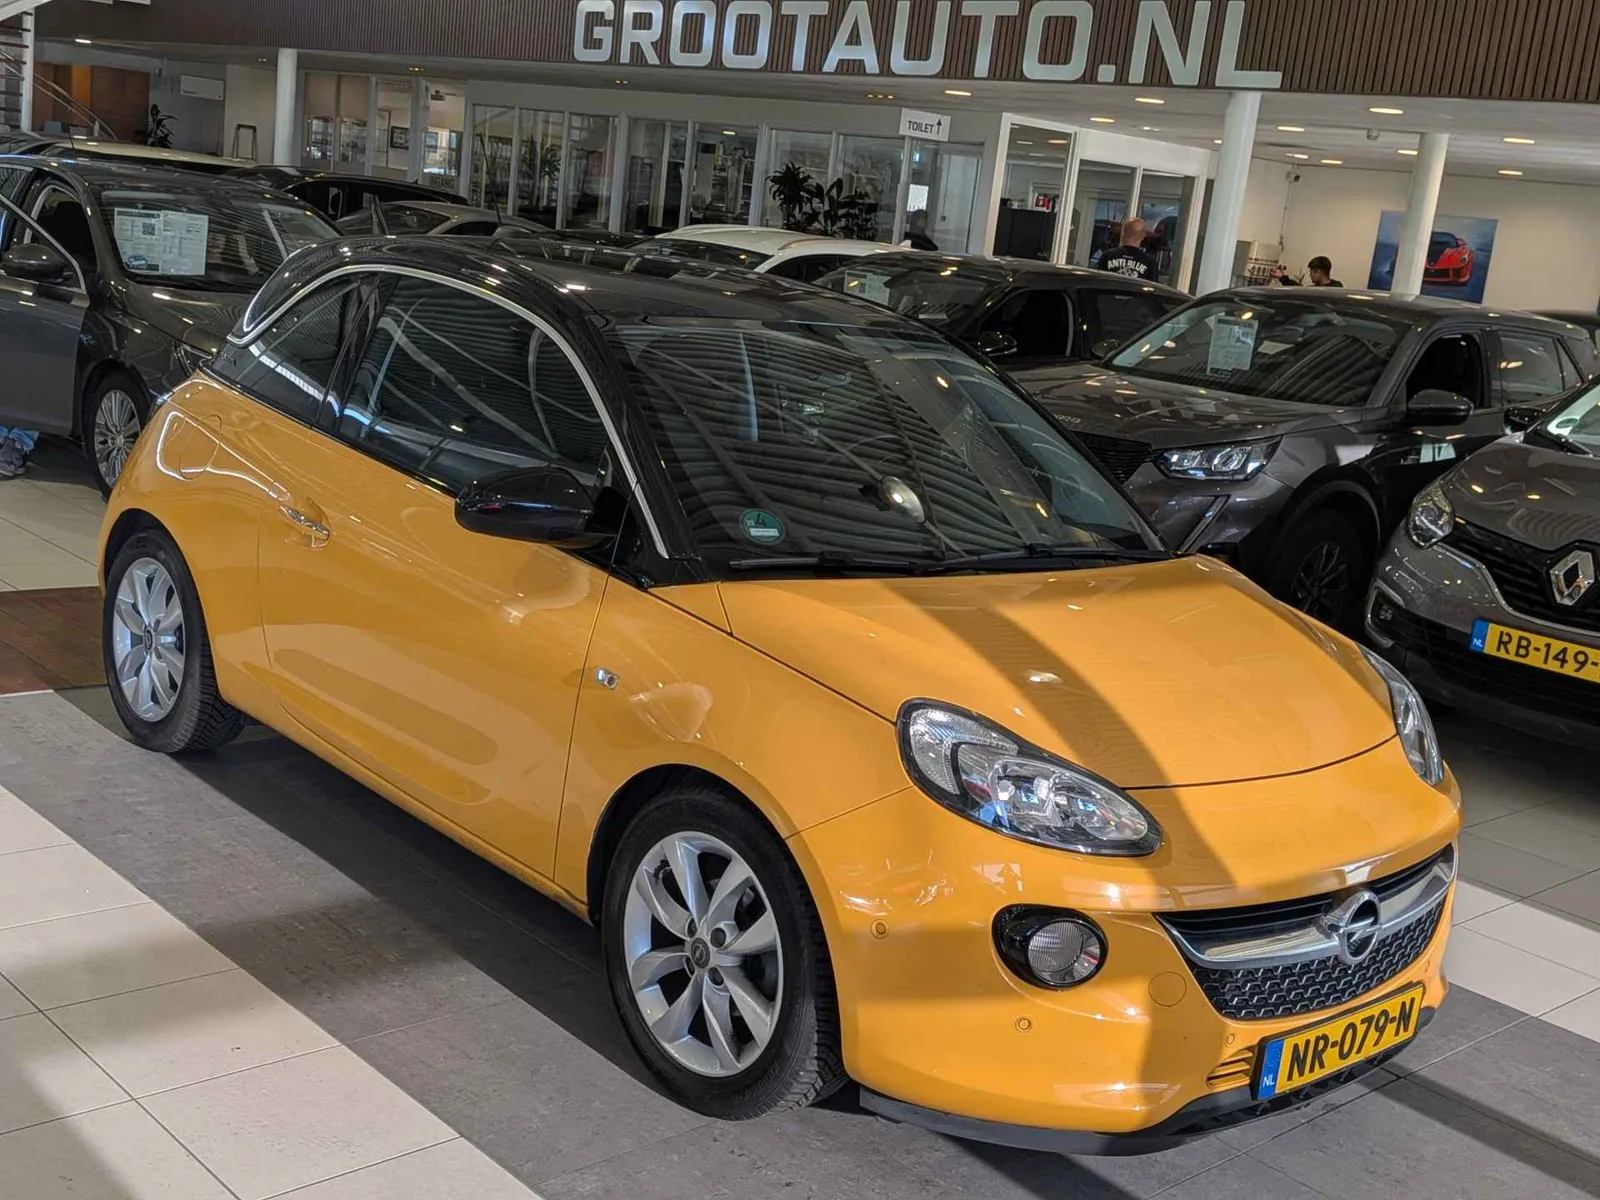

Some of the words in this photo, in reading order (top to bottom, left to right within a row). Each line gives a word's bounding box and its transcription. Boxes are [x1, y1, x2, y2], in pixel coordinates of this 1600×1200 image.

[573, 0, 1283, 89] GROOTAUTO.NL
[908, 120, 934, 134] TOILET
[1108, 258, 1126, 270] ANTI
[1127, 260, 1147, 275] BLUE
[1472, 638, 1483, 648] NL
[1496, 630, 1600, 675] RB-149-
[1286, 996, 1415, 1082] NR-079-N
[1262, 1073, 1275, 1088] NL
